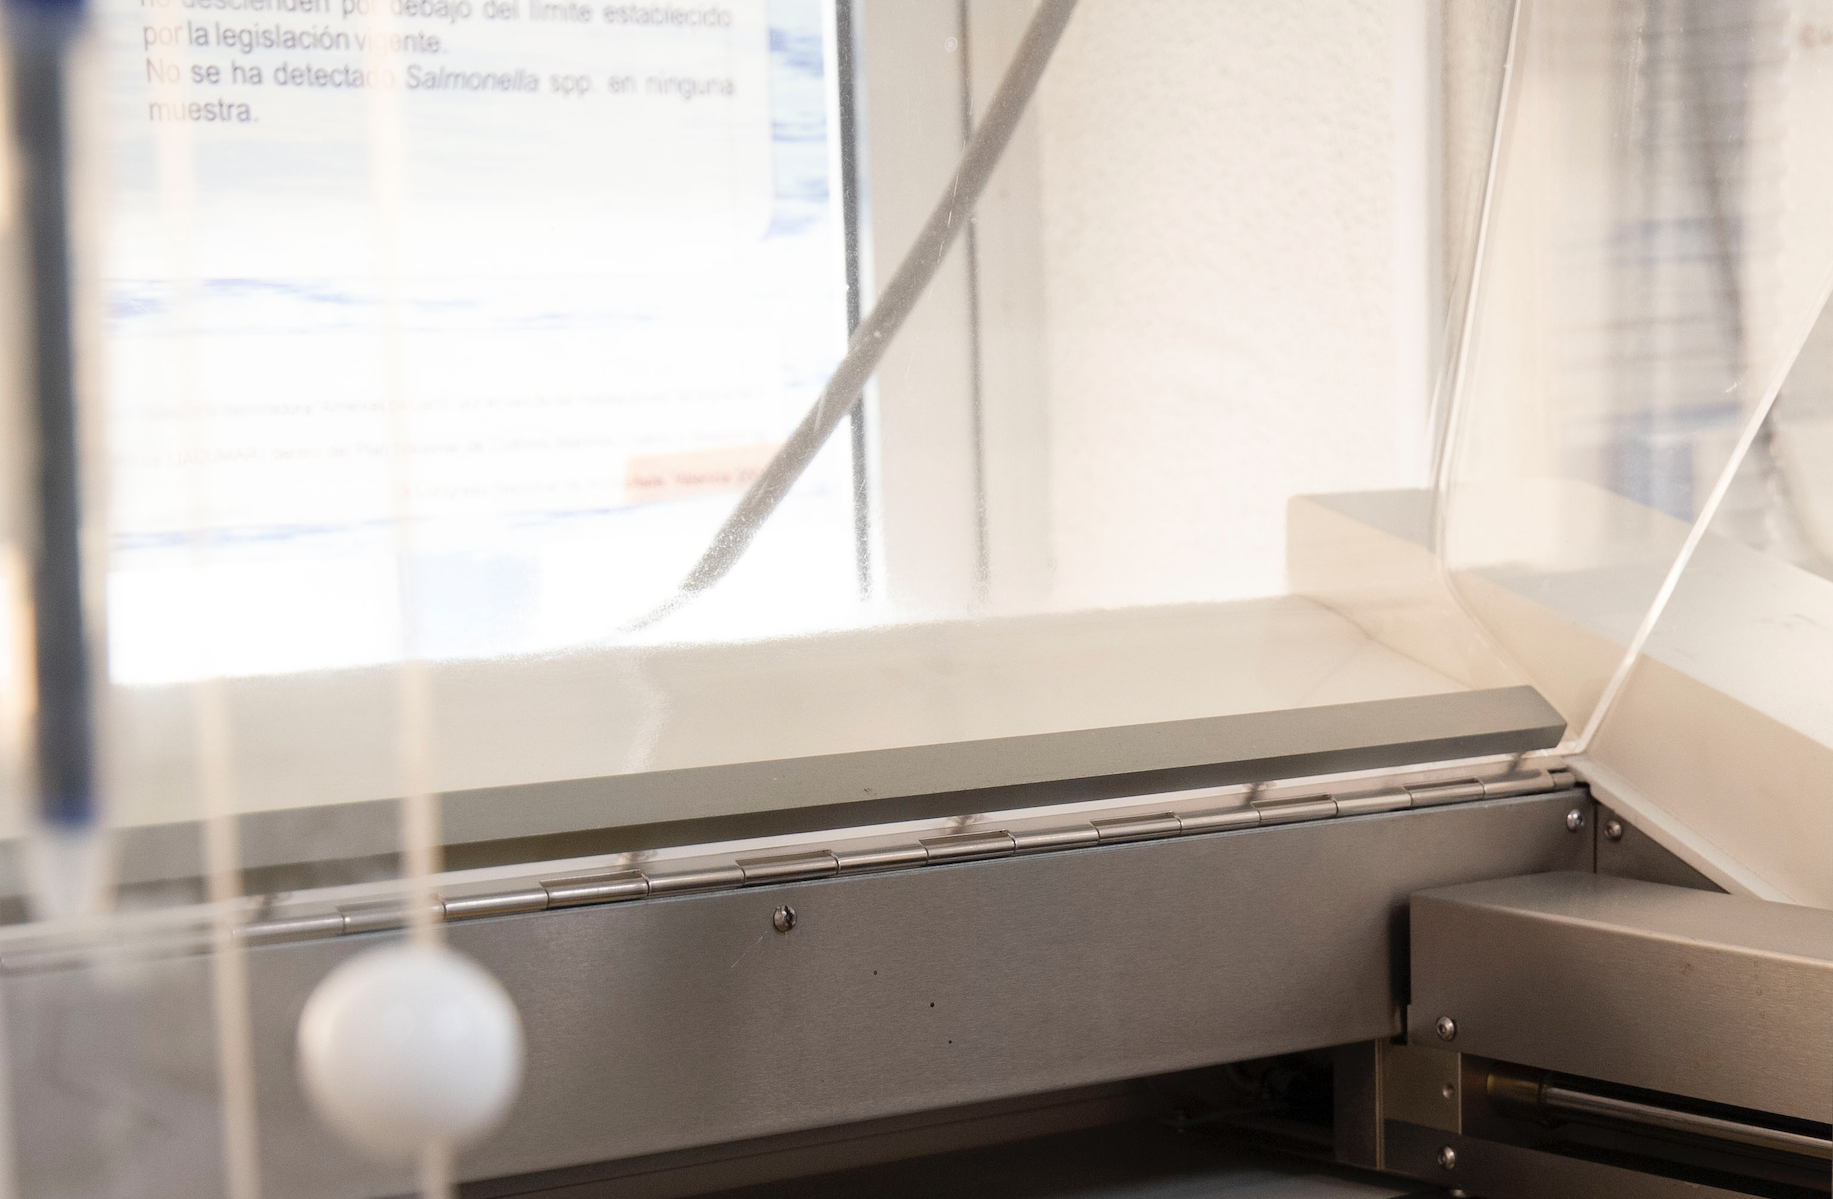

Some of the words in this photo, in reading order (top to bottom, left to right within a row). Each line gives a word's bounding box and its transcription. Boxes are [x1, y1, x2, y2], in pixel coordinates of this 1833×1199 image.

[483, 0, 518, 19] del
[143, 24, 182, 50] por
[187, 20, 209, 47] la
[215, 22, 350, 54] legislación
[146, 57, 180, 84] No
[190, 64, 220, 85] se
[231, 60, 262, 85] ha
[273, 61, 395, 88] detectado
[406, 64, 539, 91] Salmonella
[607, 74, 637, 94] en
[149, 97, 259, 122] muestra.
